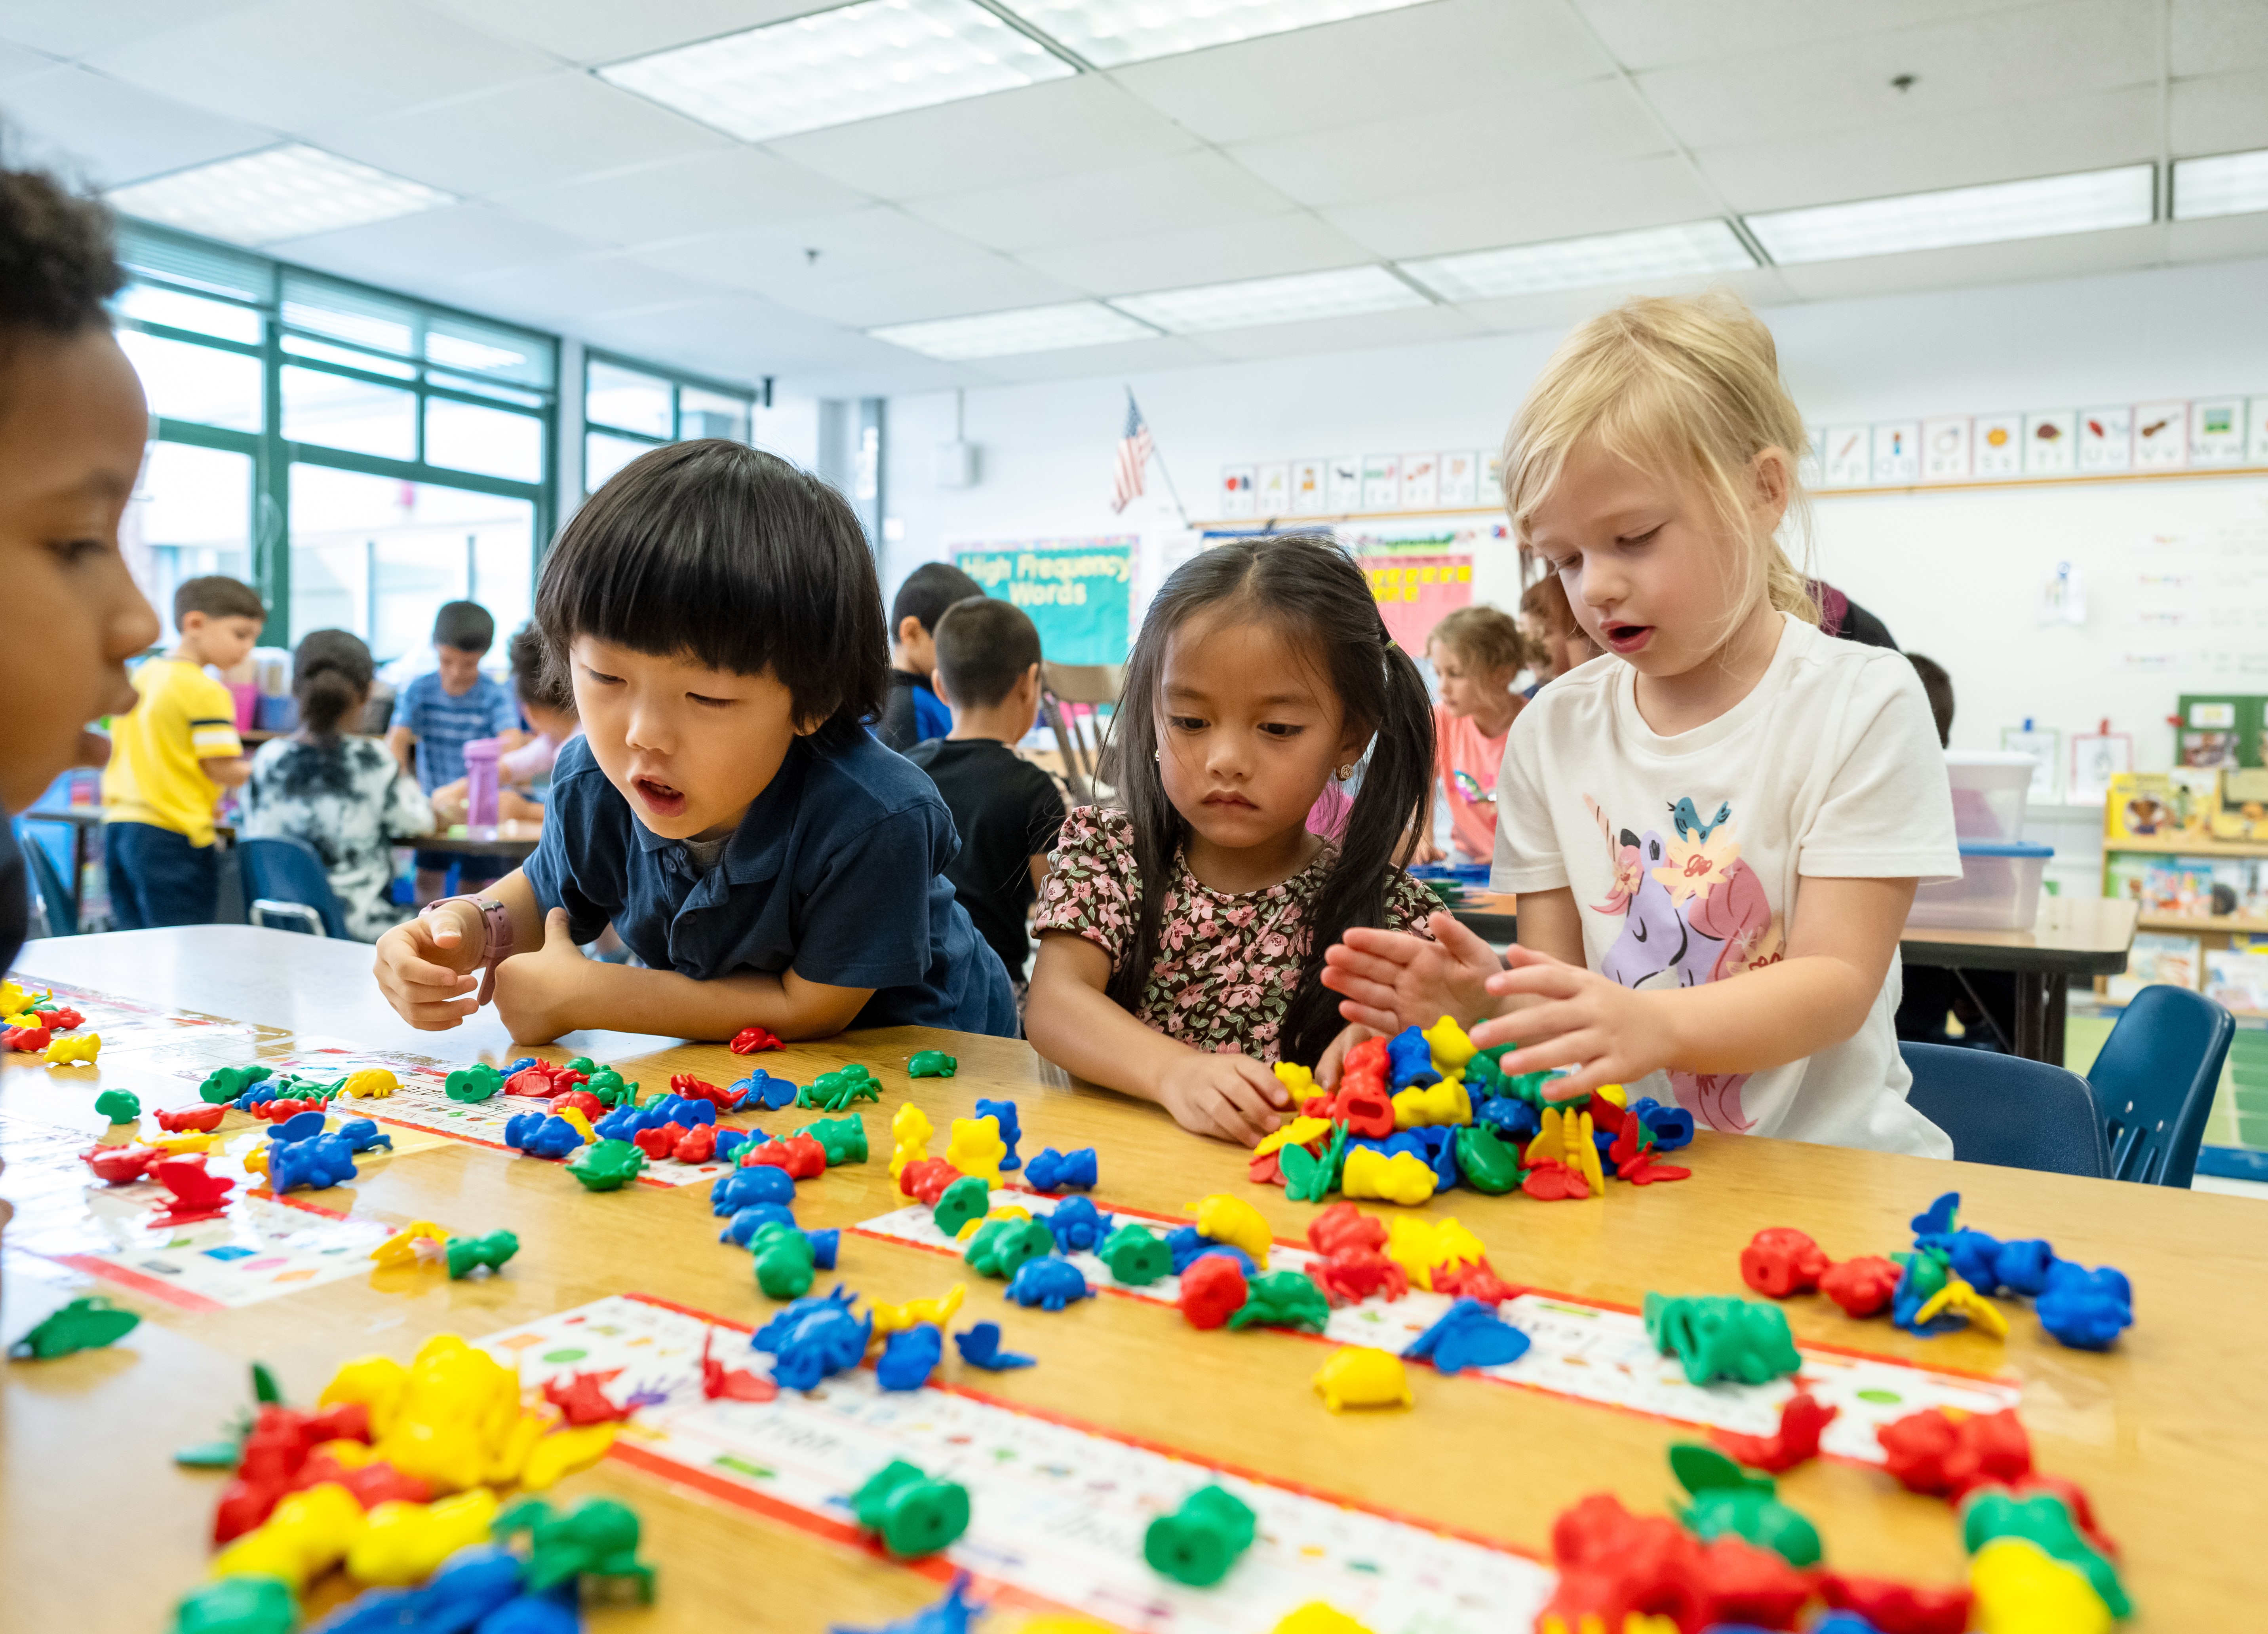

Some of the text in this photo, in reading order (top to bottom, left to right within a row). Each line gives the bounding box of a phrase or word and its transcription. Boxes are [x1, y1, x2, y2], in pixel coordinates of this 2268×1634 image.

[961, 553, 1129, 587] High Frequency
[1008, 581, 1087, 606] Words
